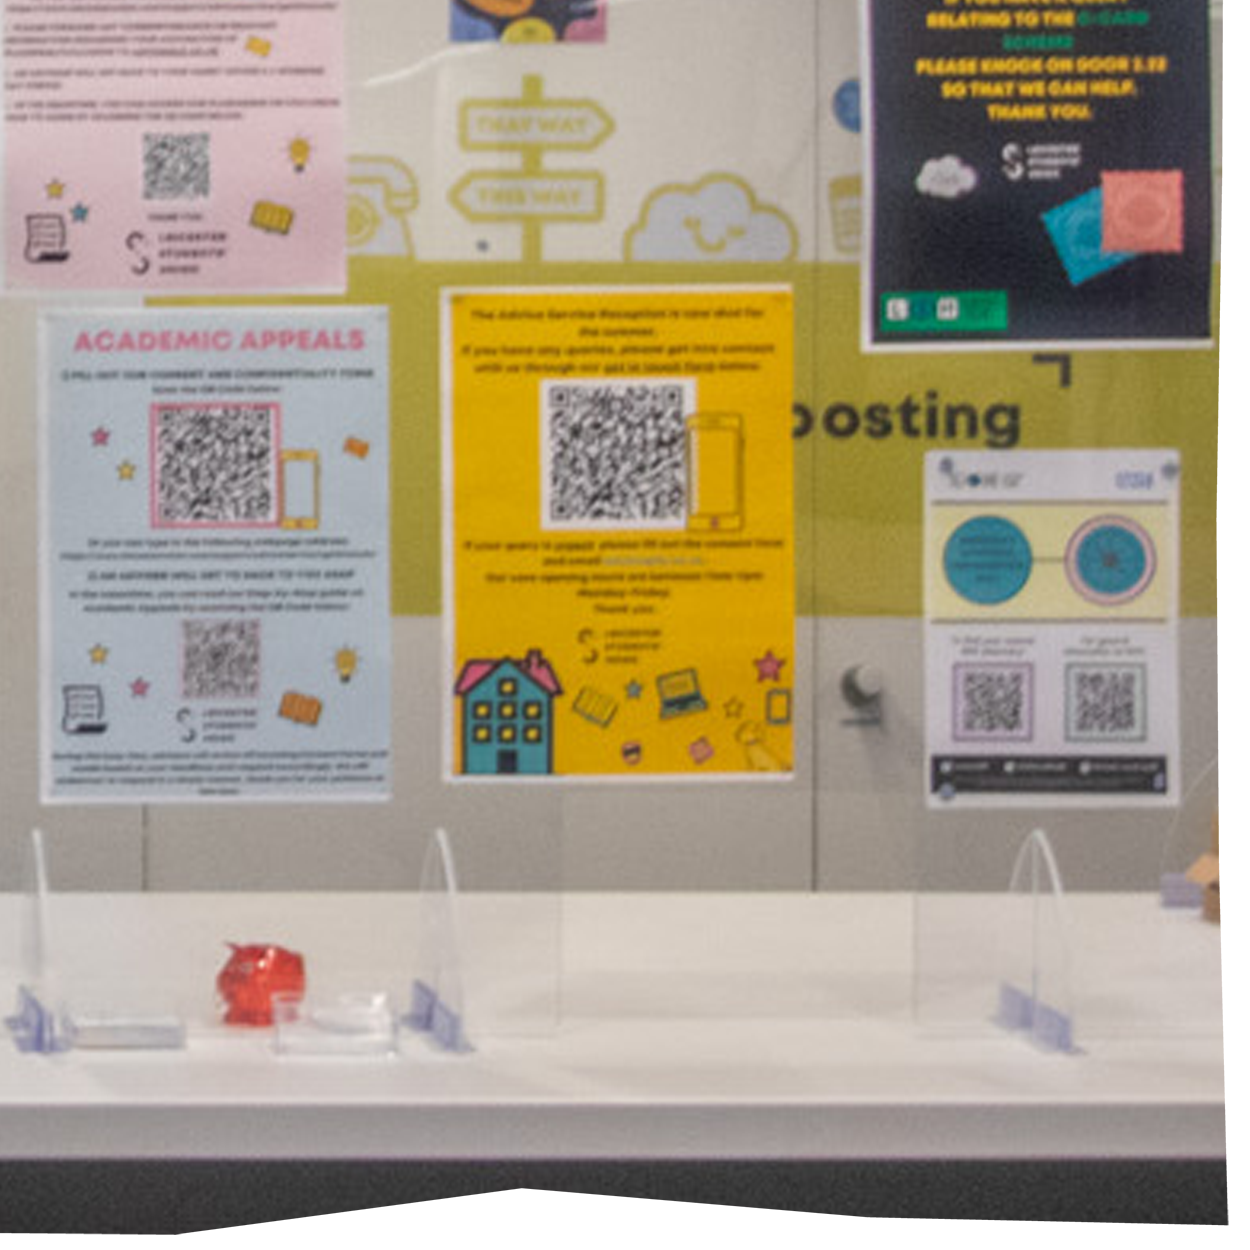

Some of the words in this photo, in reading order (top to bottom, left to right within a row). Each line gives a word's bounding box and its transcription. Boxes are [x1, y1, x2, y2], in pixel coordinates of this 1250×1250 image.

[926, 12, 1009, 28] RELATING
[1013, 12, 1039, 27] TO
[1043, 11, 1075, 27] THE
[915, 59, 976, 75] PLEASE
[981, 58, 1043, 74] KNOCK
[1047, 58, 1074, 74] ON
[1077, 57, 1128, 72] DOOR
[987, 106, 1046, 120] THANK
[73, 331, 233, 352] ACADEMIC
[239, 330, 366, 350] APPEALS
